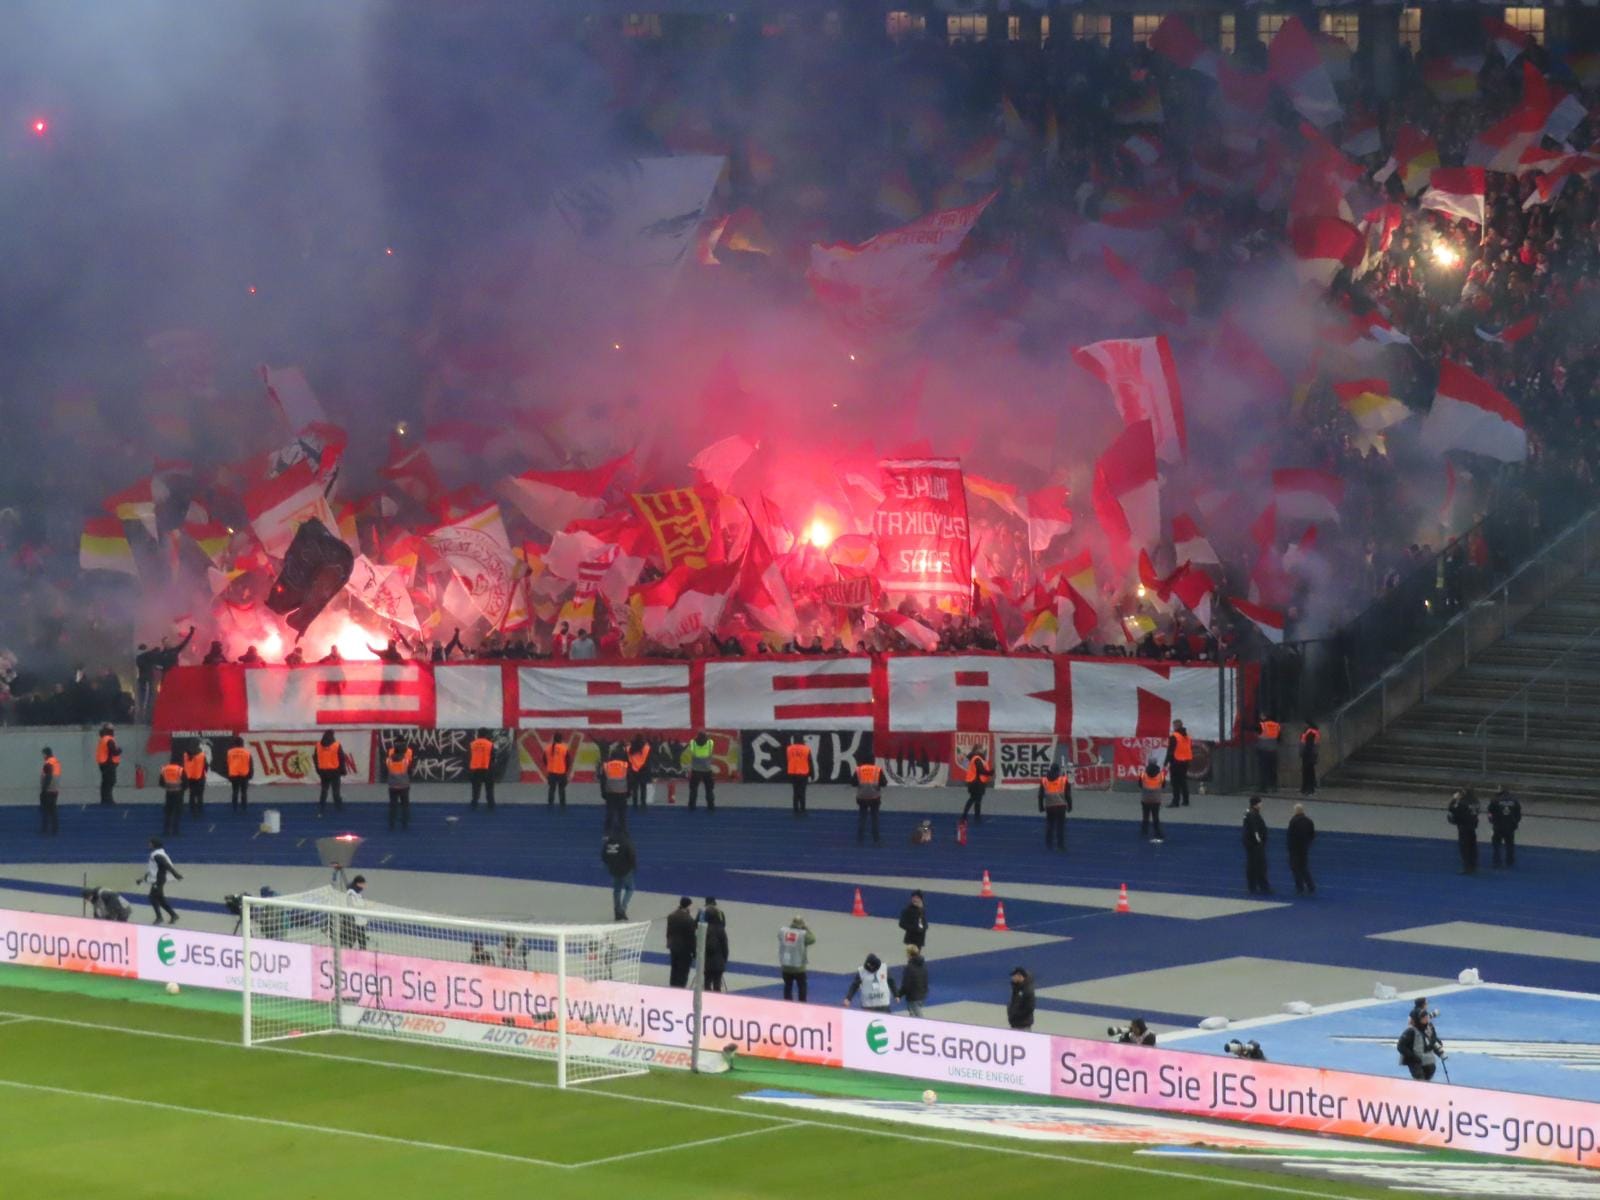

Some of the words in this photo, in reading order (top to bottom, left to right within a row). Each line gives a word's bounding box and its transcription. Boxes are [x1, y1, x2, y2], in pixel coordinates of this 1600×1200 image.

[245, 655, 1237, 743] EISERN
[1001, 744, 1050, 763] SEK
[180, 943, 291, 975] JES.GROUP
[320, 961, 392, 997] Sagen
[402, 970, 437, 1003] Sie
[444, 976, 483, 1010] JES
[492, 989, 557, 1016] unter
[566, 998, 831, 1053] www.jes-group.com!
[358, 1009, 446, 1034] AUTOHERO
[893, 1036, 1026, 1066] JES.GROUP
[948, 1066, 984, 1079] UNSERE
[985, 1070, 1025, 1085] ENERGIE
[1061, 1052, 1148, 1098] Sagen
[1159, 1064, 1200, 1101] Sie
[1209, 1072, 1257, 1109] JES
[1269, 1085, 1347, 1120] unter
